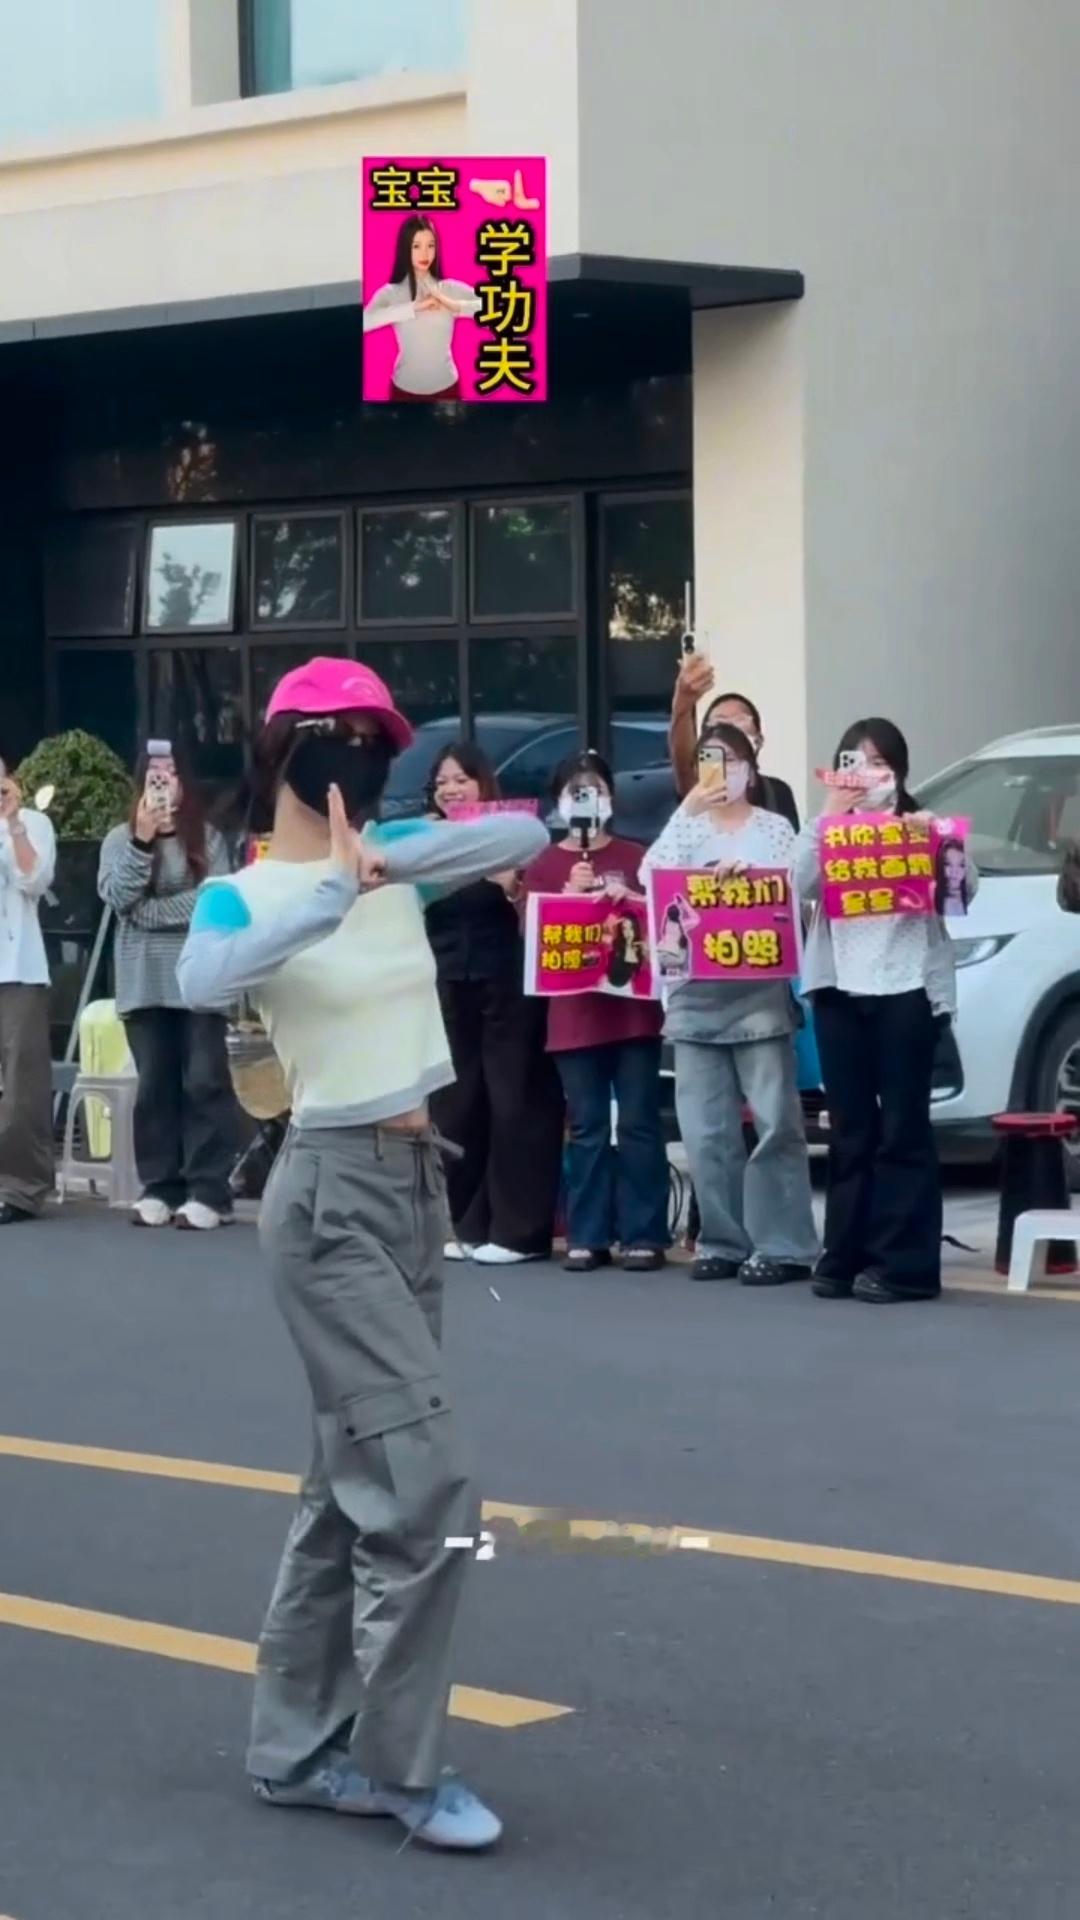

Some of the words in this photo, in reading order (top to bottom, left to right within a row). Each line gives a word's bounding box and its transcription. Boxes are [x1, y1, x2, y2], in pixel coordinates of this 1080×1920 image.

[687, 874, 785, 906] 帮我们
[543, 924, 601, 945] 帮我们
[704, 930, 779, 966] 拍照
[541, 943, 583, 970] 拍照
